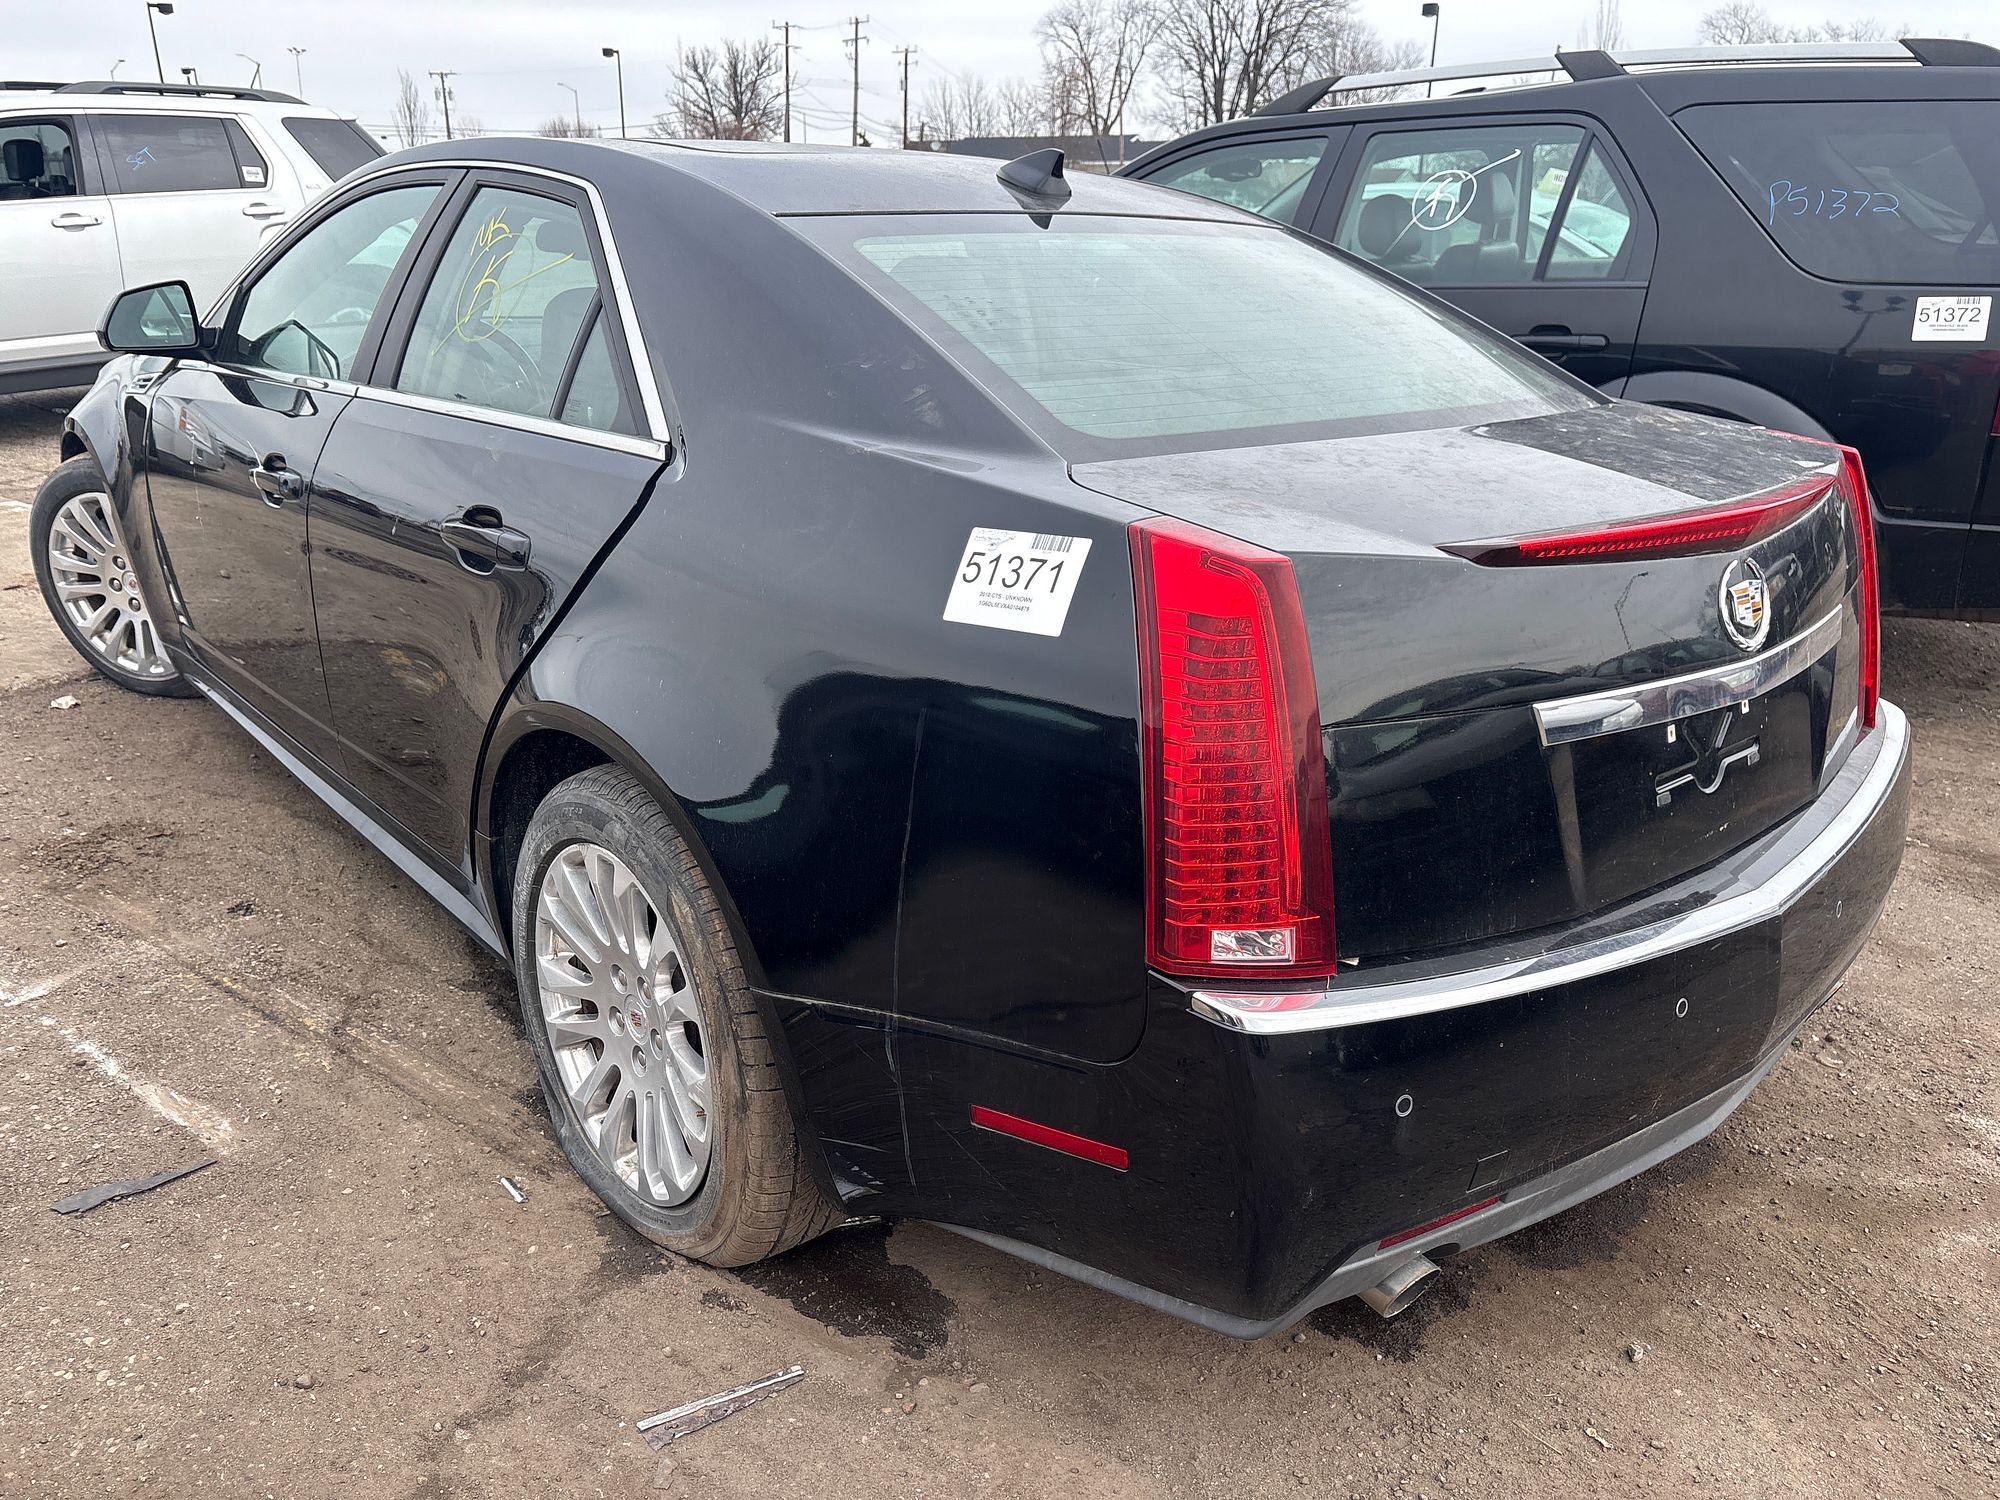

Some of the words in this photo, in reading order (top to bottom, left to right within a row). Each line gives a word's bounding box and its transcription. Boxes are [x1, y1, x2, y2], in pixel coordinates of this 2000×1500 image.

[1769, 180, 1901, 226] P51372
[1918, 307, 1981, 323] 51372
[962, 551, 1065, 594] 51371
